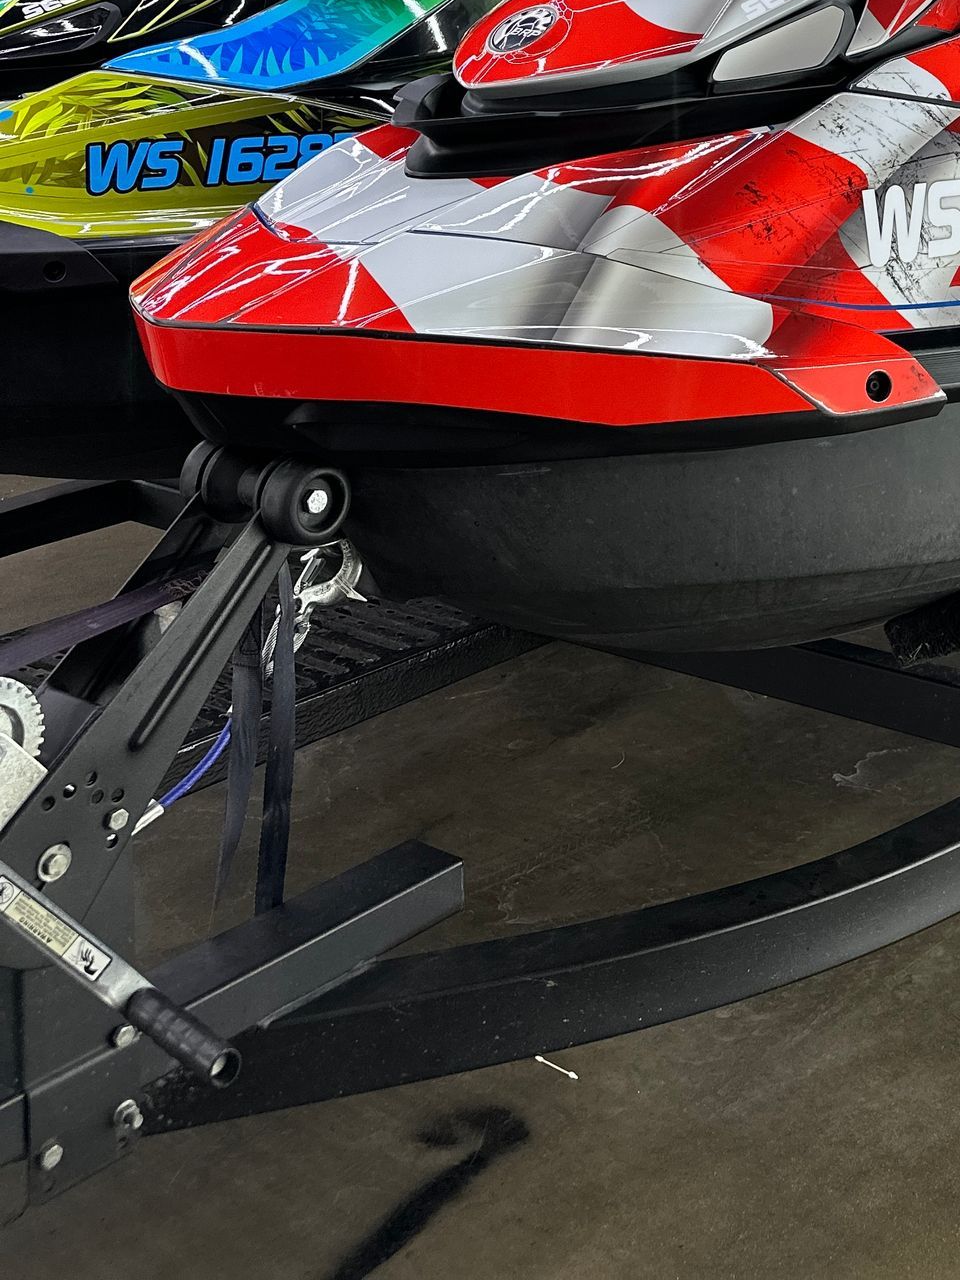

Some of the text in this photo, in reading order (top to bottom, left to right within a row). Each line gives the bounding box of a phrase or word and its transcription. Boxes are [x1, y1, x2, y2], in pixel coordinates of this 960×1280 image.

[511, 27, 542, 38] BRP
[87, 131, 358, 195] WS 1628
